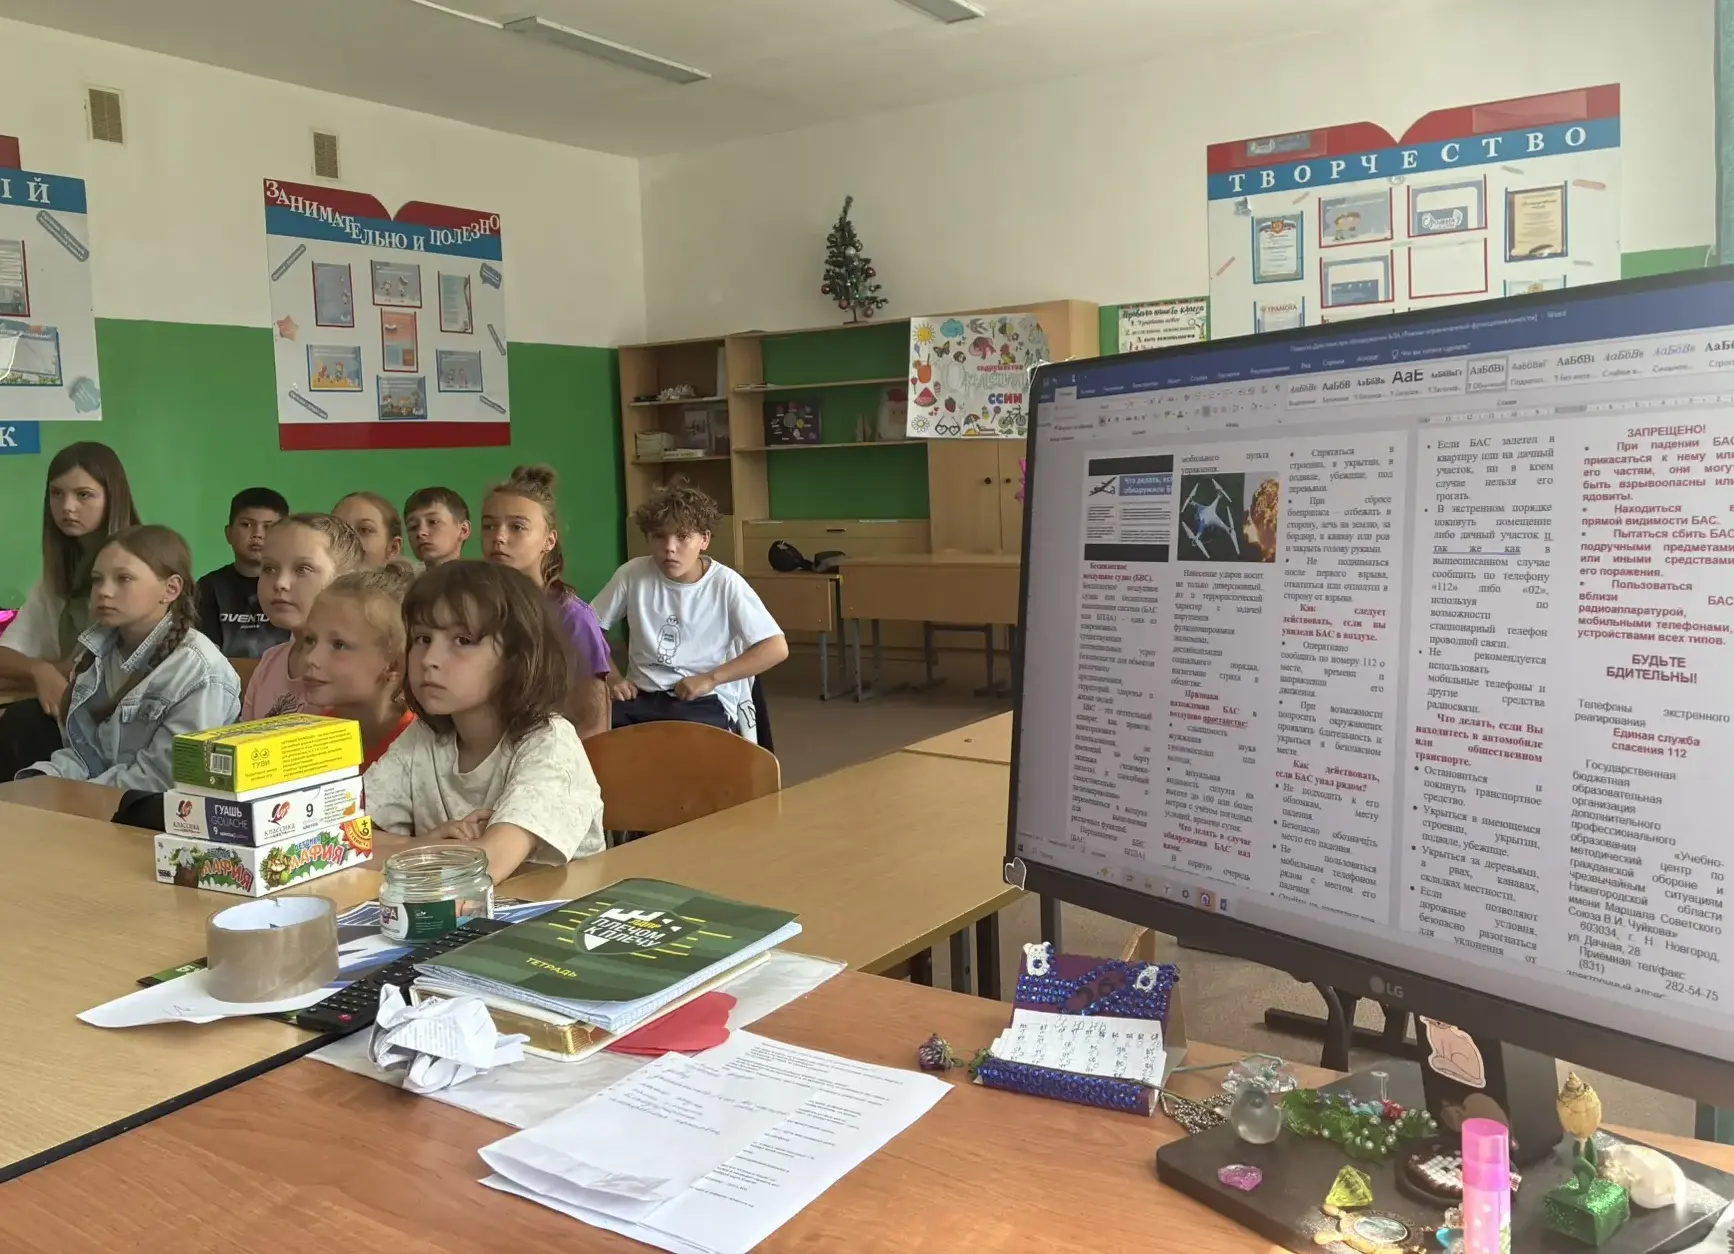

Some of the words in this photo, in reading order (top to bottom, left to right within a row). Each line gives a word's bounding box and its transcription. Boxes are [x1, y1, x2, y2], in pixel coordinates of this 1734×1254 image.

[1228, 126, 1587, 193] ТВОРЧЕСТВО
[266, 180, 407, 248] ЗАНИМАТЕЛЬНО
[413, 235, 425, 251] И
[429, 215, 500, 246] ПОЛЕЗНО
[1627, 424, 1706, 438] ЗАПРЕЩЕНО!
[1437, 440, 1460, 449] Если
[1469, 437, 1492, 447] БАС
[1617, 441, 1638, 452] При
[1650, 439, 1699, 451] падении
[1437, 452, 1478, 464] квартиру
[1584, 454, 1652, 466] прикасаться
[1677, 452, 1706, 462] нему
[1436, 466, 1474, 477] участок,
[1529, 463, 1554, 472] коем
[1583, 469, 1601, 477] его
[1613, 467, 1655, 476] частям,
[1669, 466, 1691, 474] они
[1436, 479, 1466, 490] случае
[1485, 478, 1517, 487] нельзя
[1537, 478, 1554, 486] его
[1583, 480, 1611, 489] быть
[1619, 477, 1706, 489] взрывоопасны
[1582, 492, 1634, 502] ядовиты.
[1451, 505, 1505, 515] экстренном
[1512, 503, 1552, 513] порядке
[1614, 504, 1682, 514] Находиться
[1434, 518, 1476, 528] покинуть
[1496, 518, 1552, 527] помещение
[1582, 516, 1623, 527] прямой
[1625, 516, 1689, 526] видимости
[1691, 515, 1720, 525] БАС.
[1433, 530, 1455, 539] либо
[1460, 530, 1495, 540] дачный
[1500, 531, 1540, 542] участок
[1613, 528, 1669, 539] Пытаться
[1672, 529, 1706, 539] сбить
[1710, 528, 1734, 539] БАС
[1580, 542, 1651, 553] подручными
[1663, 543, 1734, 554] предметами
[1516, 559, 1550, 569] случае
[1580, 555, 1600, 563] или
[1613, 555, 1651, 564] иными
[1665, 556, 1734, 566] средствами
[1432, 570, 1476, 580] сообщить
[1503, 573, 1550, 583] телефону
[1579, 567, 1597, 576] его
[1600, 567, 1664, 577] поражения.
[1431, 582, 1458, 592] «112»
[1612, 579, 1693, 591] Пользоваться
[1431, 596, 1477, 607] используя
[1579, 592, 1618, 601] вблизи
[1708, 596, 1734, 606] БАС
[1430, 608, 1491, 620] возможности
[1578, 603, 1687, 618] радиоаппаратурой,
[1507, 627, 1548, 638] телефон
[1578, 616, 1651, 628] мобильными
[1656, 621, 1733, 634] телефонами,
[1429, 635, 1478, 647] проводной
[1577, 628, 1655, 641] устройствами
[1658, 634, 1684, 643] всех
[1688, 635, 1726, 645] типов.
[1363, 657, 1377, 667] 112
[1428, 647, 1442, 657] Не
[1474, 651, 1547, 665] рекомендуется
[1632, 654, 1687, 668] БУДЬТЕ
[1428, 661, 1490, 674] использовать
[1606, 666, 1698, 684] БДИТЕЛЬНЫ!
[1427, 674, 1480, 687] мобильные
[1485, 678, 1533, 692] телефоны
[1502, 695, 1545, 708] средства
[1578, 698, 1633, 713] Телефоны
[1663, 708, 1730, 723] экстренного
[1437, 713, 1456, 724] Что
[1458, 717, 1495, 730] делать,
[1498, 722, 1522, 732] если
[1526, 723, 1544, 735] Вы
[1574, 712, 1646, 728] реагирования
[1415, 725, 1469, 739] находитесь
[1481, 735, 1544, 749] автомобиле
[1613, 727, 1655, 741] Единая
[1657, 734, 1701, 747] служба
[1468, 744, 1543, 763] общественном
[1612, 741, 1664, 756] спасения
[1668, 747, 1687, 759] 112
[1415, 751, 1472, 767] транспорте.
[1424, 765, 1488, 783] Остановиться
[1585, 759, 1676, 780] Государственная
[1572, 770, 1631, 787] бюджетная
[1475, 787, 1542, 806] транспортное
[1572, 783, 1663, 805] образовательная
[214, 804, 243, 818] ГУАШЬ
[305, 803, 314, 818] 9
[1571, 796, 1636, 814] организация
[210, 815, 248, 830] GOUACHE
[1423, 804, 1468, 821] Укрыться
[1481, 816, 1541, 835] имеющемся
[1571, 808, 1661, 831] дополнительного
[212, 826, 218, 835] 9
[1570, 820, 1676, 846] профессионального
[1570, 833, 1637, 852] образования
[1570, 845, 1642, 866] методический
[1660, 862, 1692, 876] центр
[1569, 858, 1635, 878] гражданской
[1652, 873, 1698, 890] обороне
[1569, 870, 1646, 893] чрезвычайным
[1664, 889, 1723, 909] ситуациям
[1419, 900, 1467, 918] дорожные
[1568, 881, 1648, 906] Нижегородской
[1677, 905, 1723, 921] области
[1485, 902, 1539, 922] позволяют
[1568, 906, 1601, 921] Союза
[1605, 901, 1655, 921] Маршала
[1660, 913, 1722, 935] Советского
[583, 926, 598, 935] К
[599, 930, 662, 948] ПЛЕЧУ
[590, 918, 667, 941] ПЛЕЧОМ
[1478, 929, 1537, 951] разогнаться
[1665, 940, 1720, 963] Новгород,
[525, 957, 578, 978] ТЕТРАДЬ
[1579, 958, 1605, 974] (831)
[1665, 979, 1719, 1001] 282-54-75
[1386, 981, 1404, 998] LG
